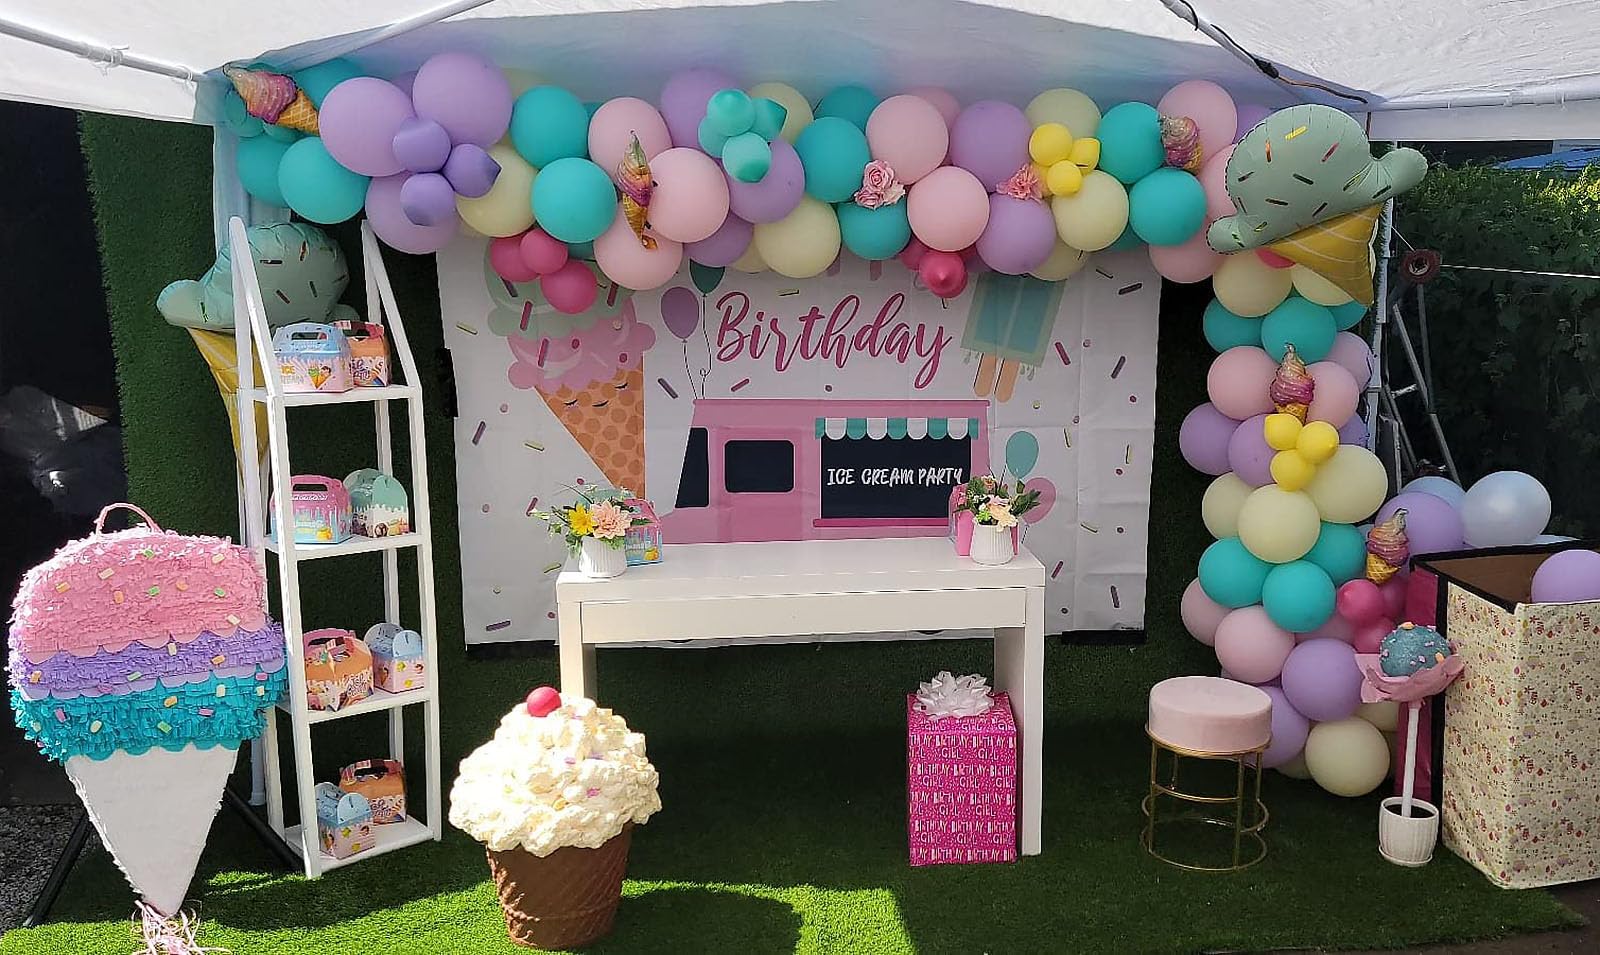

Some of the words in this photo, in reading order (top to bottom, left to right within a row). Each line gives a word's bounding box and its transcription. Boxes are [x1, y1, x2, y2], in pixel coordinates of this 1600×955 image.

[715, 291, 953, 389] Birthday
[827, 468, 855, 486] ICE
[861, 467, 914, 487] CREAM
[918, 467, 963, 487] PARTY
[936, 734, 969, 748] BIRTHAY
[972, 735, 1006, 749] BIRTHAY
[917, 762, 950, 777] BIRTHAY
[953, 763, 987, 778] BIRTHAY
[933, 791, 965, 804] BIRTHAY
[969, 792, 1002, 806] BIRTHAY
[915, 819, 948, 834] BIRTHAY
[951, 820, 984, 834] BIRTHAY
[931, 847, 964, 861] BIRTHAY
[967, 848, 1001, 862] BIRTHAY
